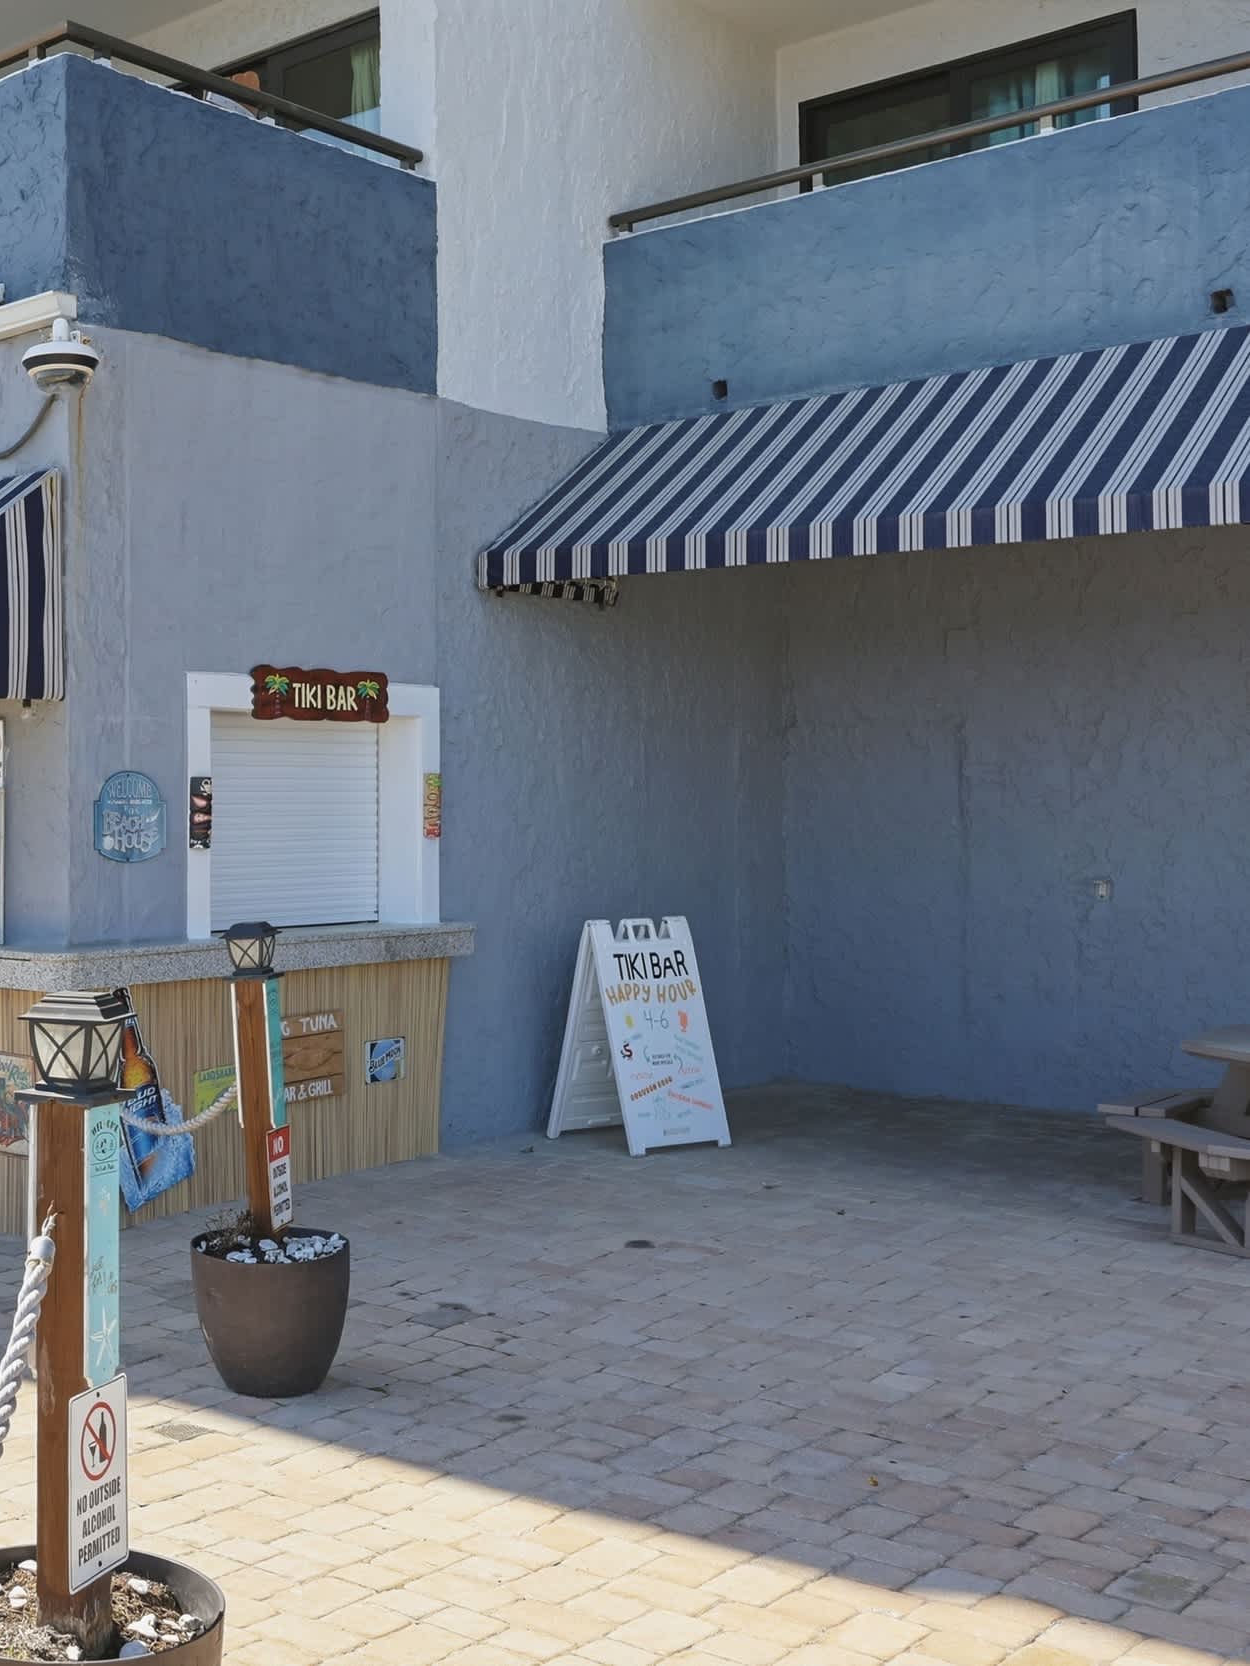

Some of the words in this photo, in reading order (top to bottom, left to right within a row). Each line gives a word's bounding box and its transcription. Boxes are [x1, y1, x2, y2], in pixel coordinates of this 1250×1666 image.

[292, 682, 322, 709] TIKI
[326, 684, 358, 712] BAR
[108, 777, 153, 799] WELCOME
[612, 951, 648, 981] TIKI
[605, 982, 651, 1007] HAPPY
[656, 978, 697, 1004] HOUR
[300, 1013, 338, 1034] TUNA
[642, 1008, 670, 1031] 4-6
[283, 1086, 296, 1101] AR
[298, 1085, 309, 1100] &
[308, 1079, 334, 1097] GRILL
[273, 1135, 284, 1156] NO
[76, 1494, 88, 1517] NO
[89, 1475, 121, 1510] OUTSIDE
[82, 1503, 116, 1539] ALCOHOL
[78, 1526, 121, 1568] PERMITTED
